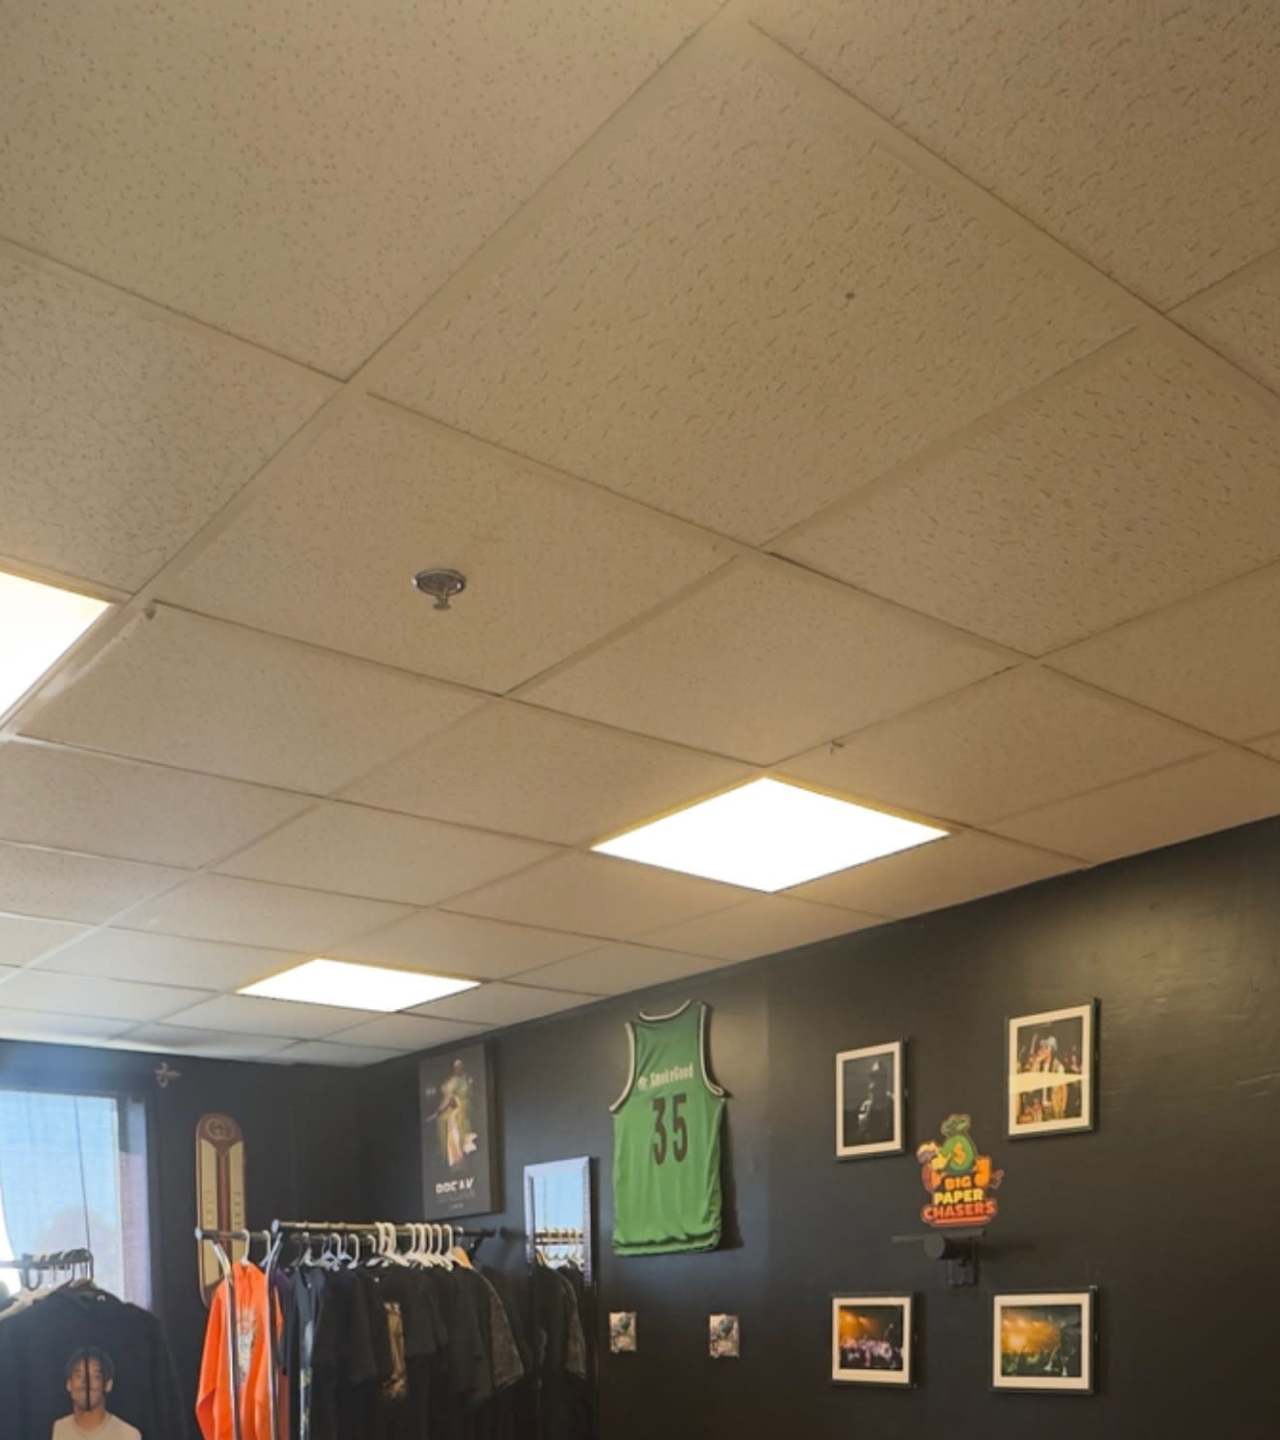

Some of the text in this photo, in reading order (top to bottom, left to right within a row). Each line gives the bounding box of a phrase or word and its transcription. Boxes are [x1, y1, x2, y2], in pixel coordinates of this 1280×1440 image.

[653, 1093, 688, 1165] 35
[944, 1175, 972, 1191] BIG
[933, 1188, 983, 1205] PAPER
[923, 1201, 995, 1219] CHASERS
